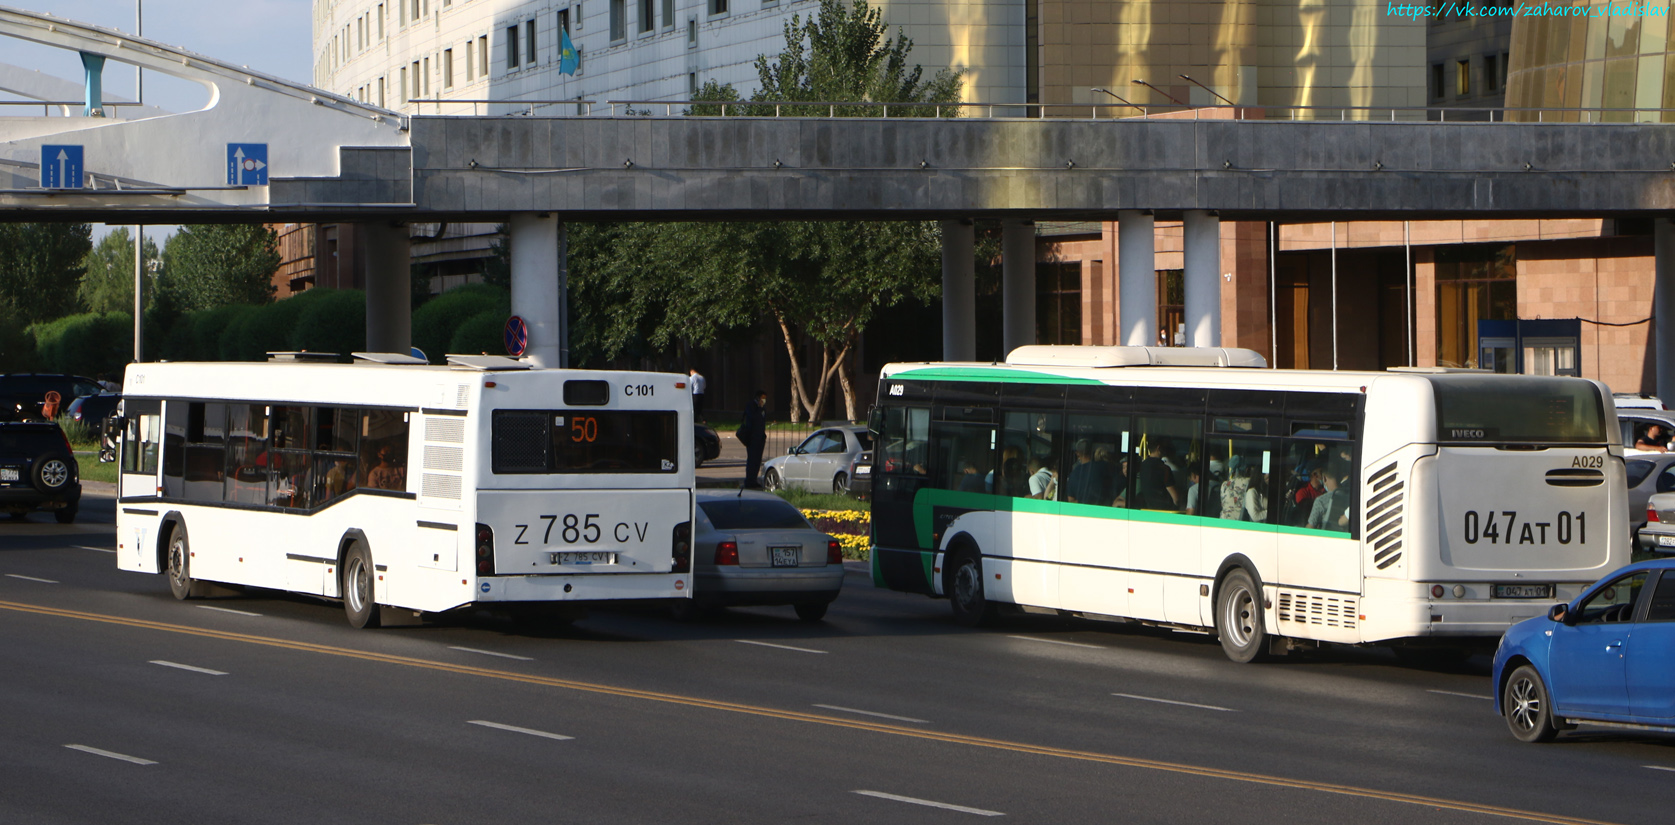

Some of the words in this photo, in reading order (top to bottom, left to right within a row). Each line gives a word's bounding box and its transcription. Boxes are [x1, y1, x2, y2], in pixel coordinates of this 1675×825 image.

[889, 384, 904, 396] A029
[571, 417, 598, 442] 50
[1451, 429, 1485, 438] IVECO
[1571, 455, 1604, 468] A029
[540, 513, 601, 544] 785
[1557, 510, 1586, 545] 01
[574, 552, 588, 561] 785
[782, 548, 795, 557] 157
[1506, 587, 1520, 596] 047
